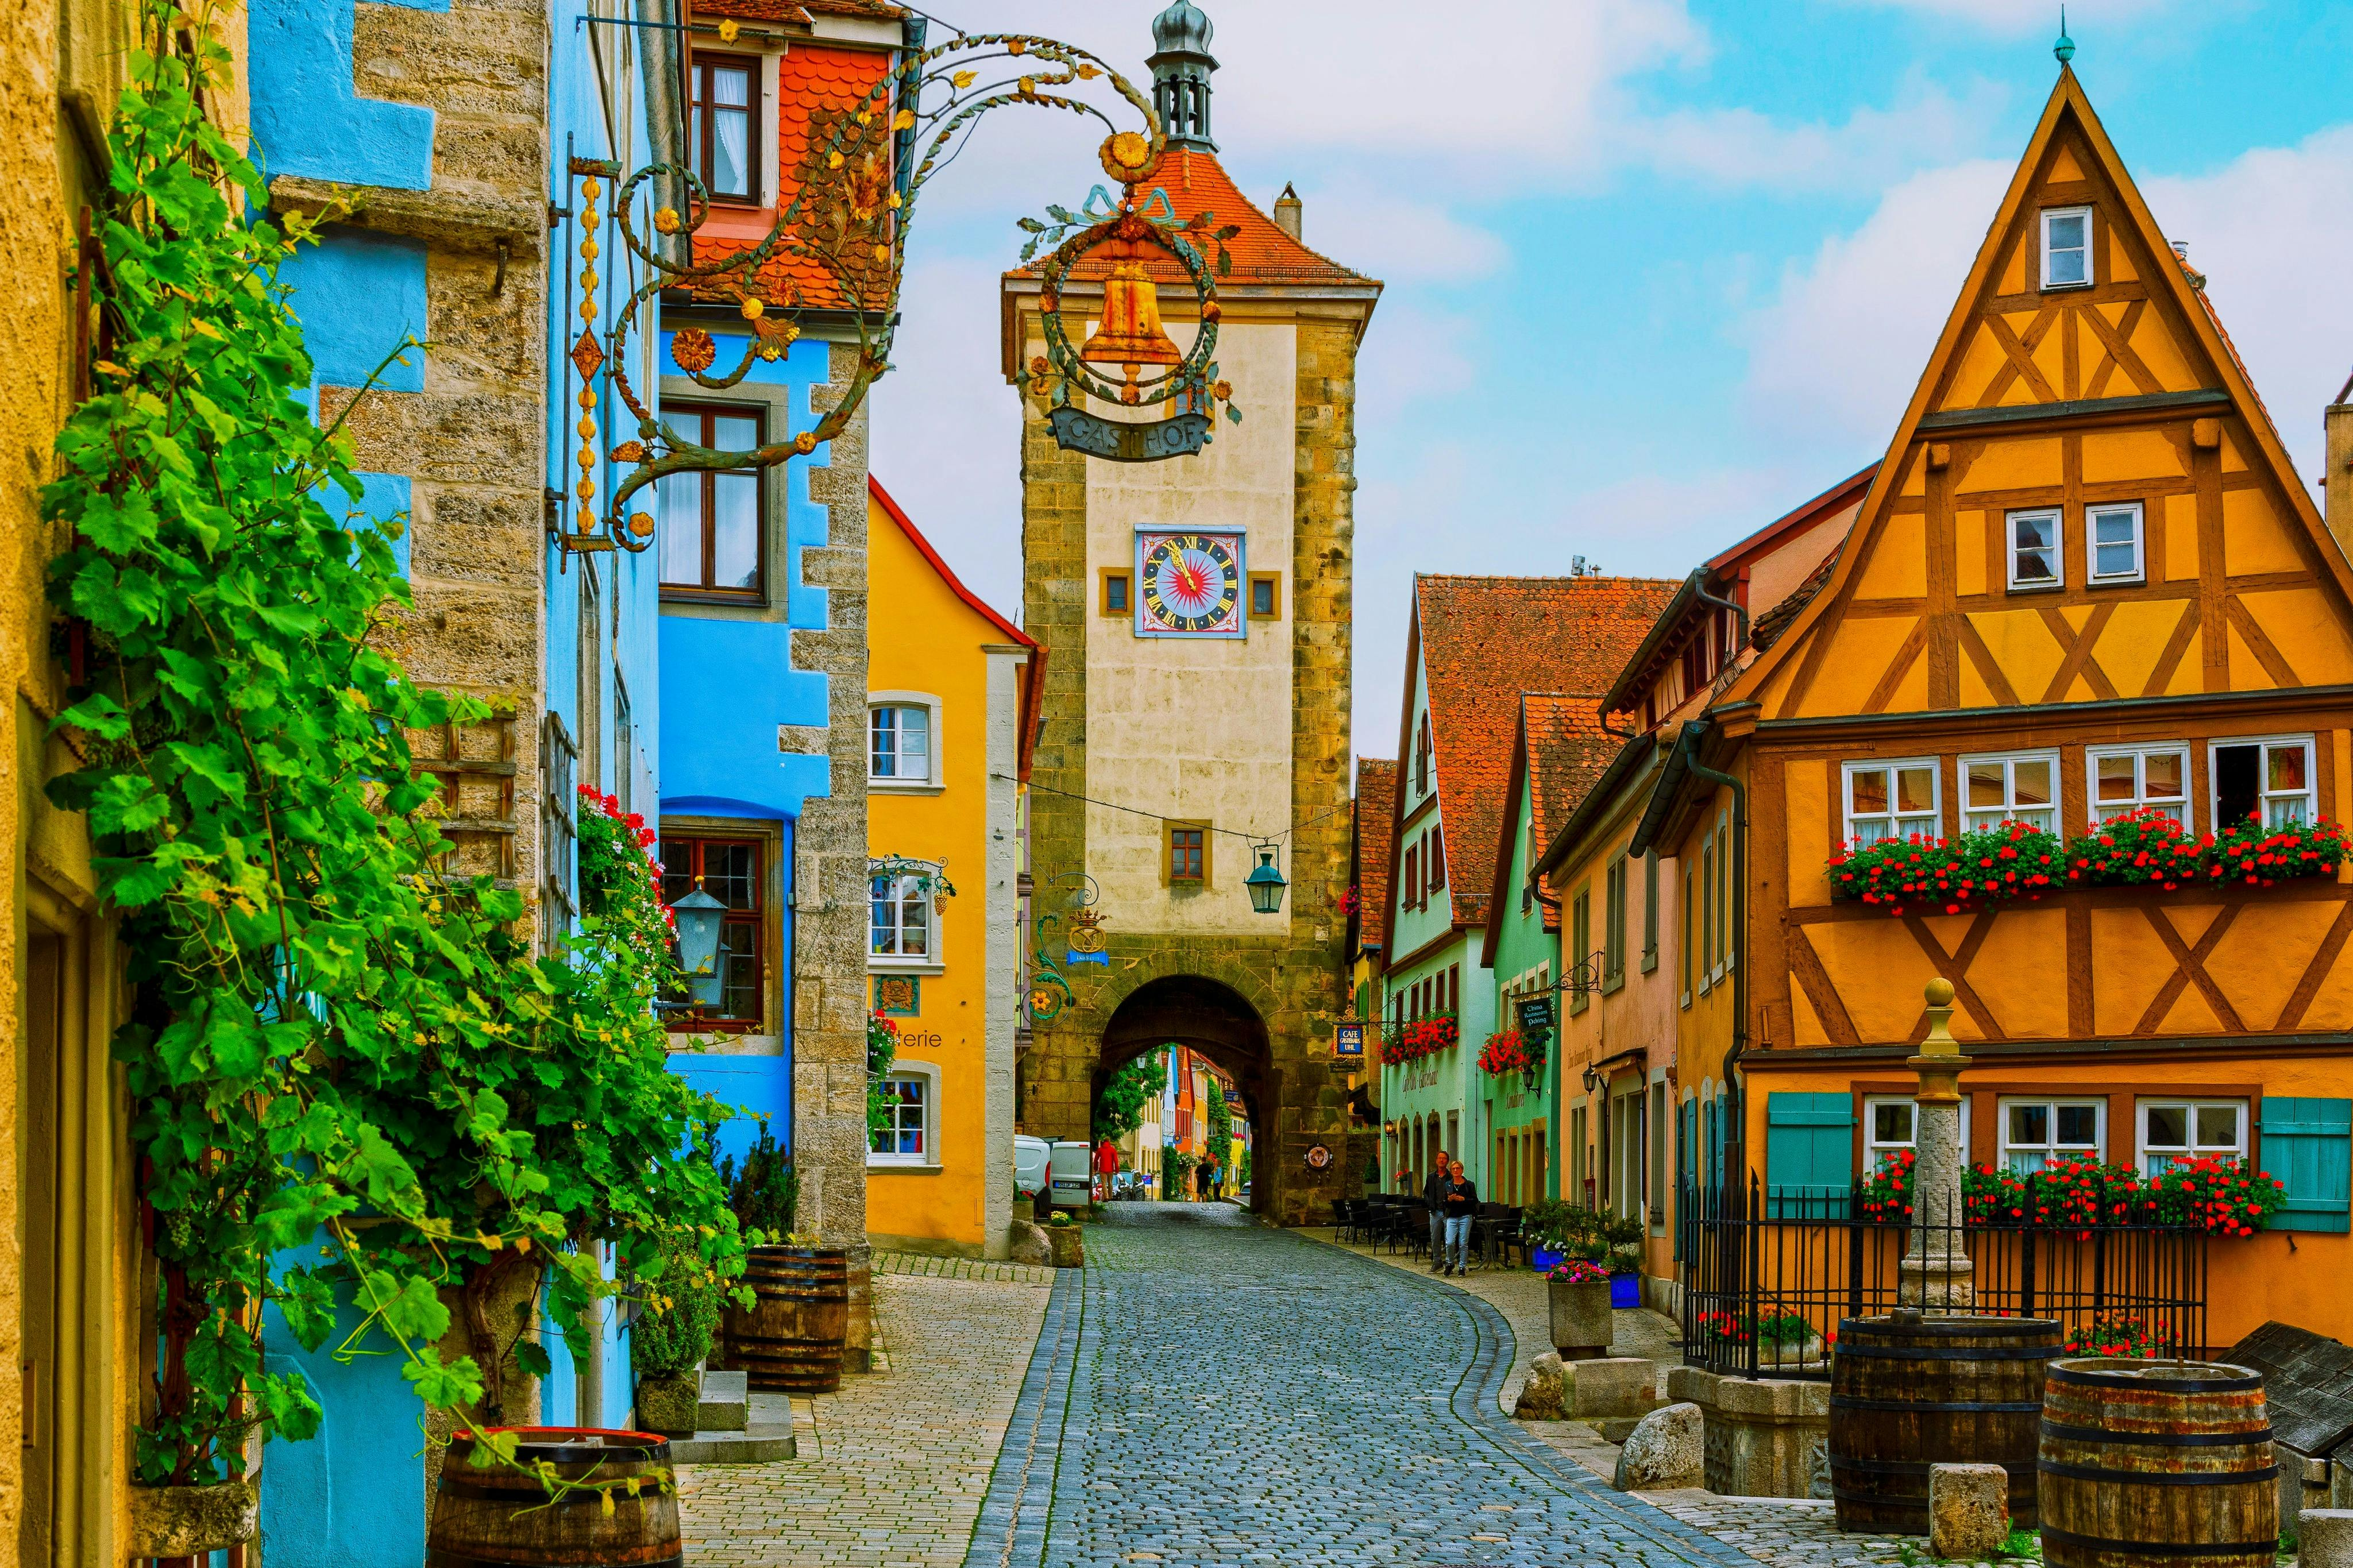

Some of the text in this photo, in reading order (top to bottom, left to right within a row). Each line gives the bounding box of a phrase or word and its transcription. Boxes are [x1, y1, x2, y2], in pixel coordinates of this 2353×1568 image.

[1069, 416, 1195, 452] GASTHOF
[1182, 536, 1198, 549] XII
[1219, 558, 1233, 570] II
[1207, 613, 1218, 627] V
